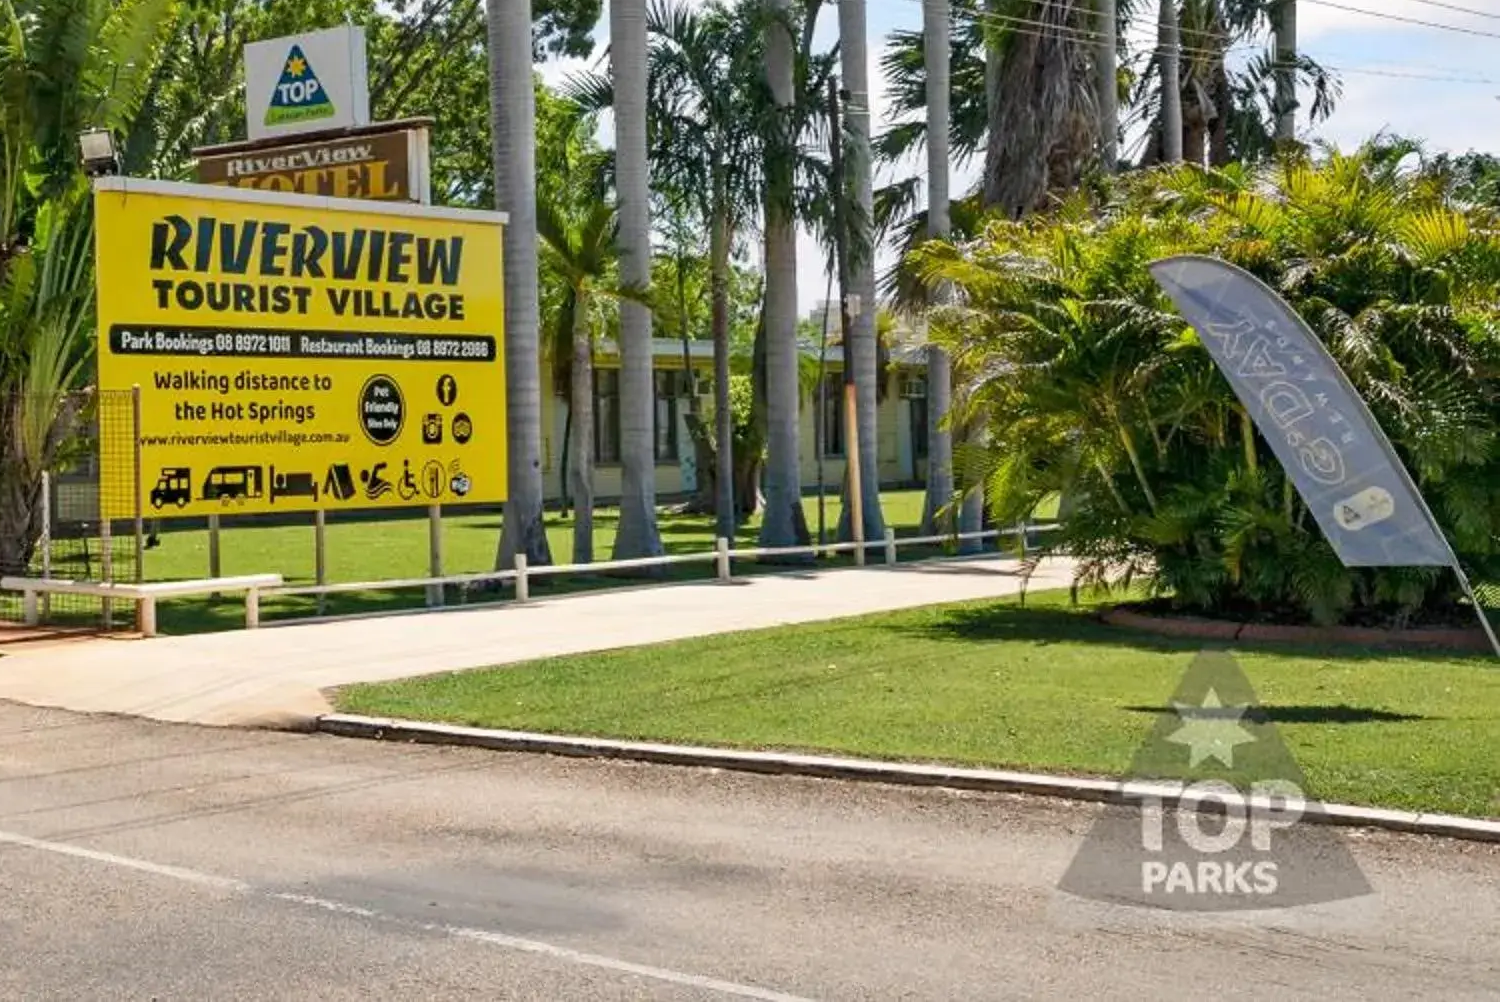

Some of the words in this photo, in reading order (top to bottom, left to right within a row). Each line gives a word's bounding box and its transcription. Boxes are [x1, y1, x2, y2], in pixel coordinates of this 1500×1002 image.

[278, 79, 318, 104] TOP
[150, 214, 463, 286] RIVERVIEW
[152, 279, 312, 315] TOURIST
[327, 287, 465, 321] VILLAGE
[121, 331, 153, 349] Park
[155, 332, 214, 354] Bookings
[215, 333, 233, 351] 08
[235, 334, 267, 352] 8972
[301, 336, 364, 355] Restaurant
[365, 337, 415, 359] Bookings
[154, 370, 229, 395] Walking
[234, 370, 310, 391] distance
[314, 374, 332, 391] to
[174, 401, 206, 421] the
[211, 401, 244, 421] Hot
[249, 399, 316, 425] Springs
[139, 430, 351, 447] www.riverviewtouristvillage.com.au
